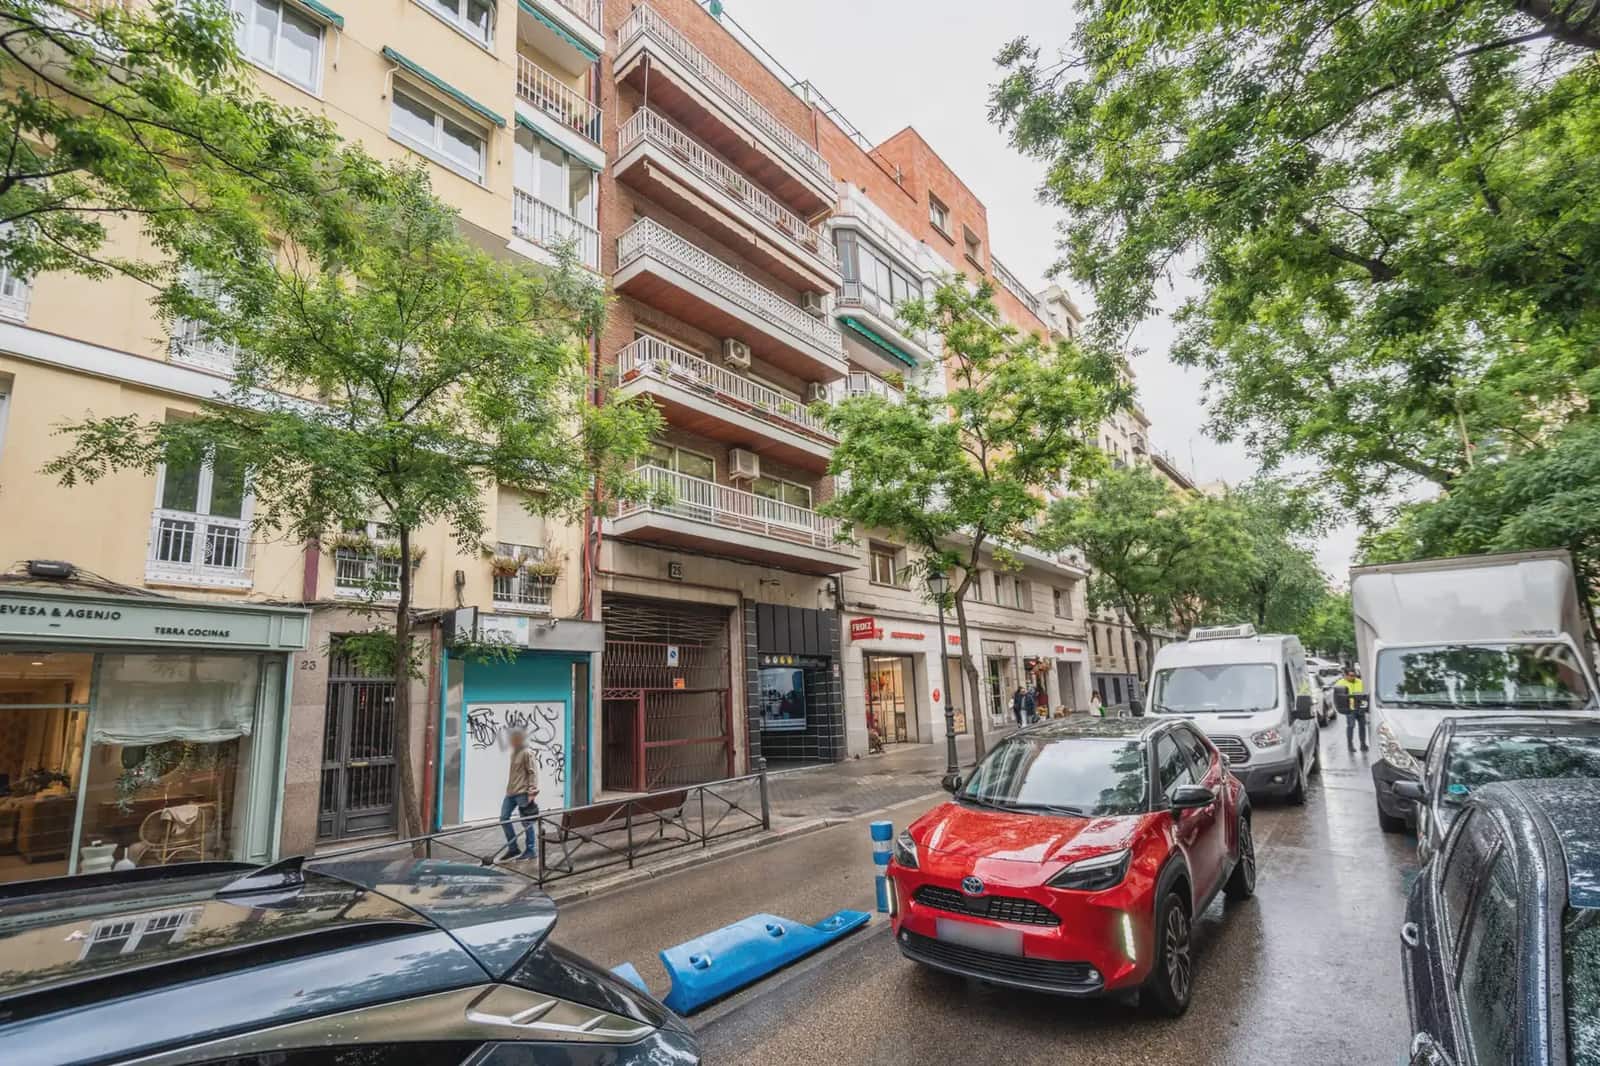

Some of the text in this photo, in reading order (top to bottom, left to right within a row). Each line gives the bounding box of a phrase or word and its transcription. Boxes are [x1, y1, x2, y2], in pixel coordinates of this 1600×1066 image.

[51, 607, 61, 617] &
[65, 609, 121, 620] AGENJO
[154, 626, 230, 638] TERRA COCINAS
[300, 660, 317, 671] 23
